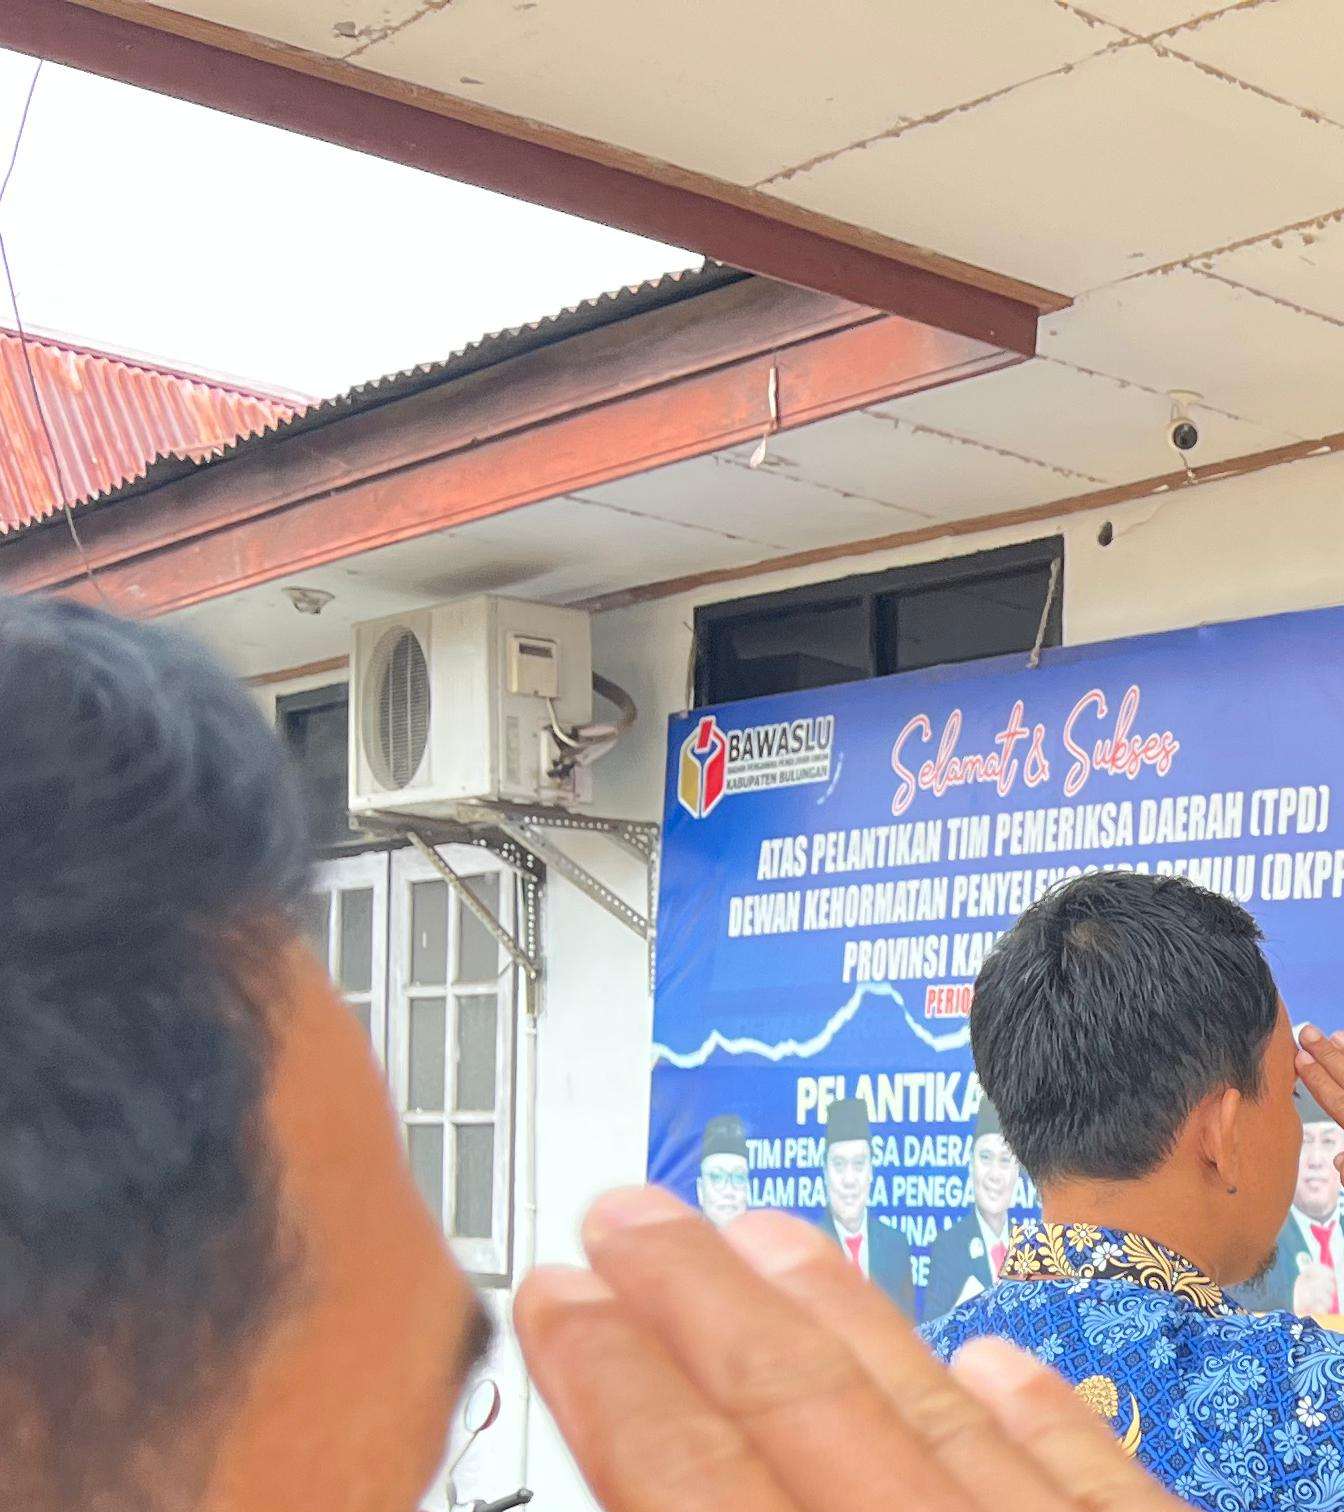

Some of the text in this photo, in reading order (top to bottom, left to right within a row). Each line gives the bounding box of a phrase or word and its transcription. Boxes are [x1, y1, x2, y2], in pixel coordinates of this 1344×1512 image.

[729, 716, 832, 763] BAWASLU
[892, 684, 1180, 816] Selamat & Sukses
[727, 765, 828, 790] KABUPATEN BULUNGAN
[757, 784, 1330, 881] ATAS PELANTIKAN TIM PEMERIKSA DAERAH (TPD)
[728, 890, 800, 938] DEWAN
[803, 876, 949, 932] KEHORMATAN
[951, 862, 1149, 920] PENYELE
[842, 934, 948, 983] PROVINSI
[925, 984, 973, 1018] PERIO
[796, 1071, 986, 1126] PEANTIKA
[745, 1138, 782, 1170] TIM
[904, 1134, 974, 1168] DAER
